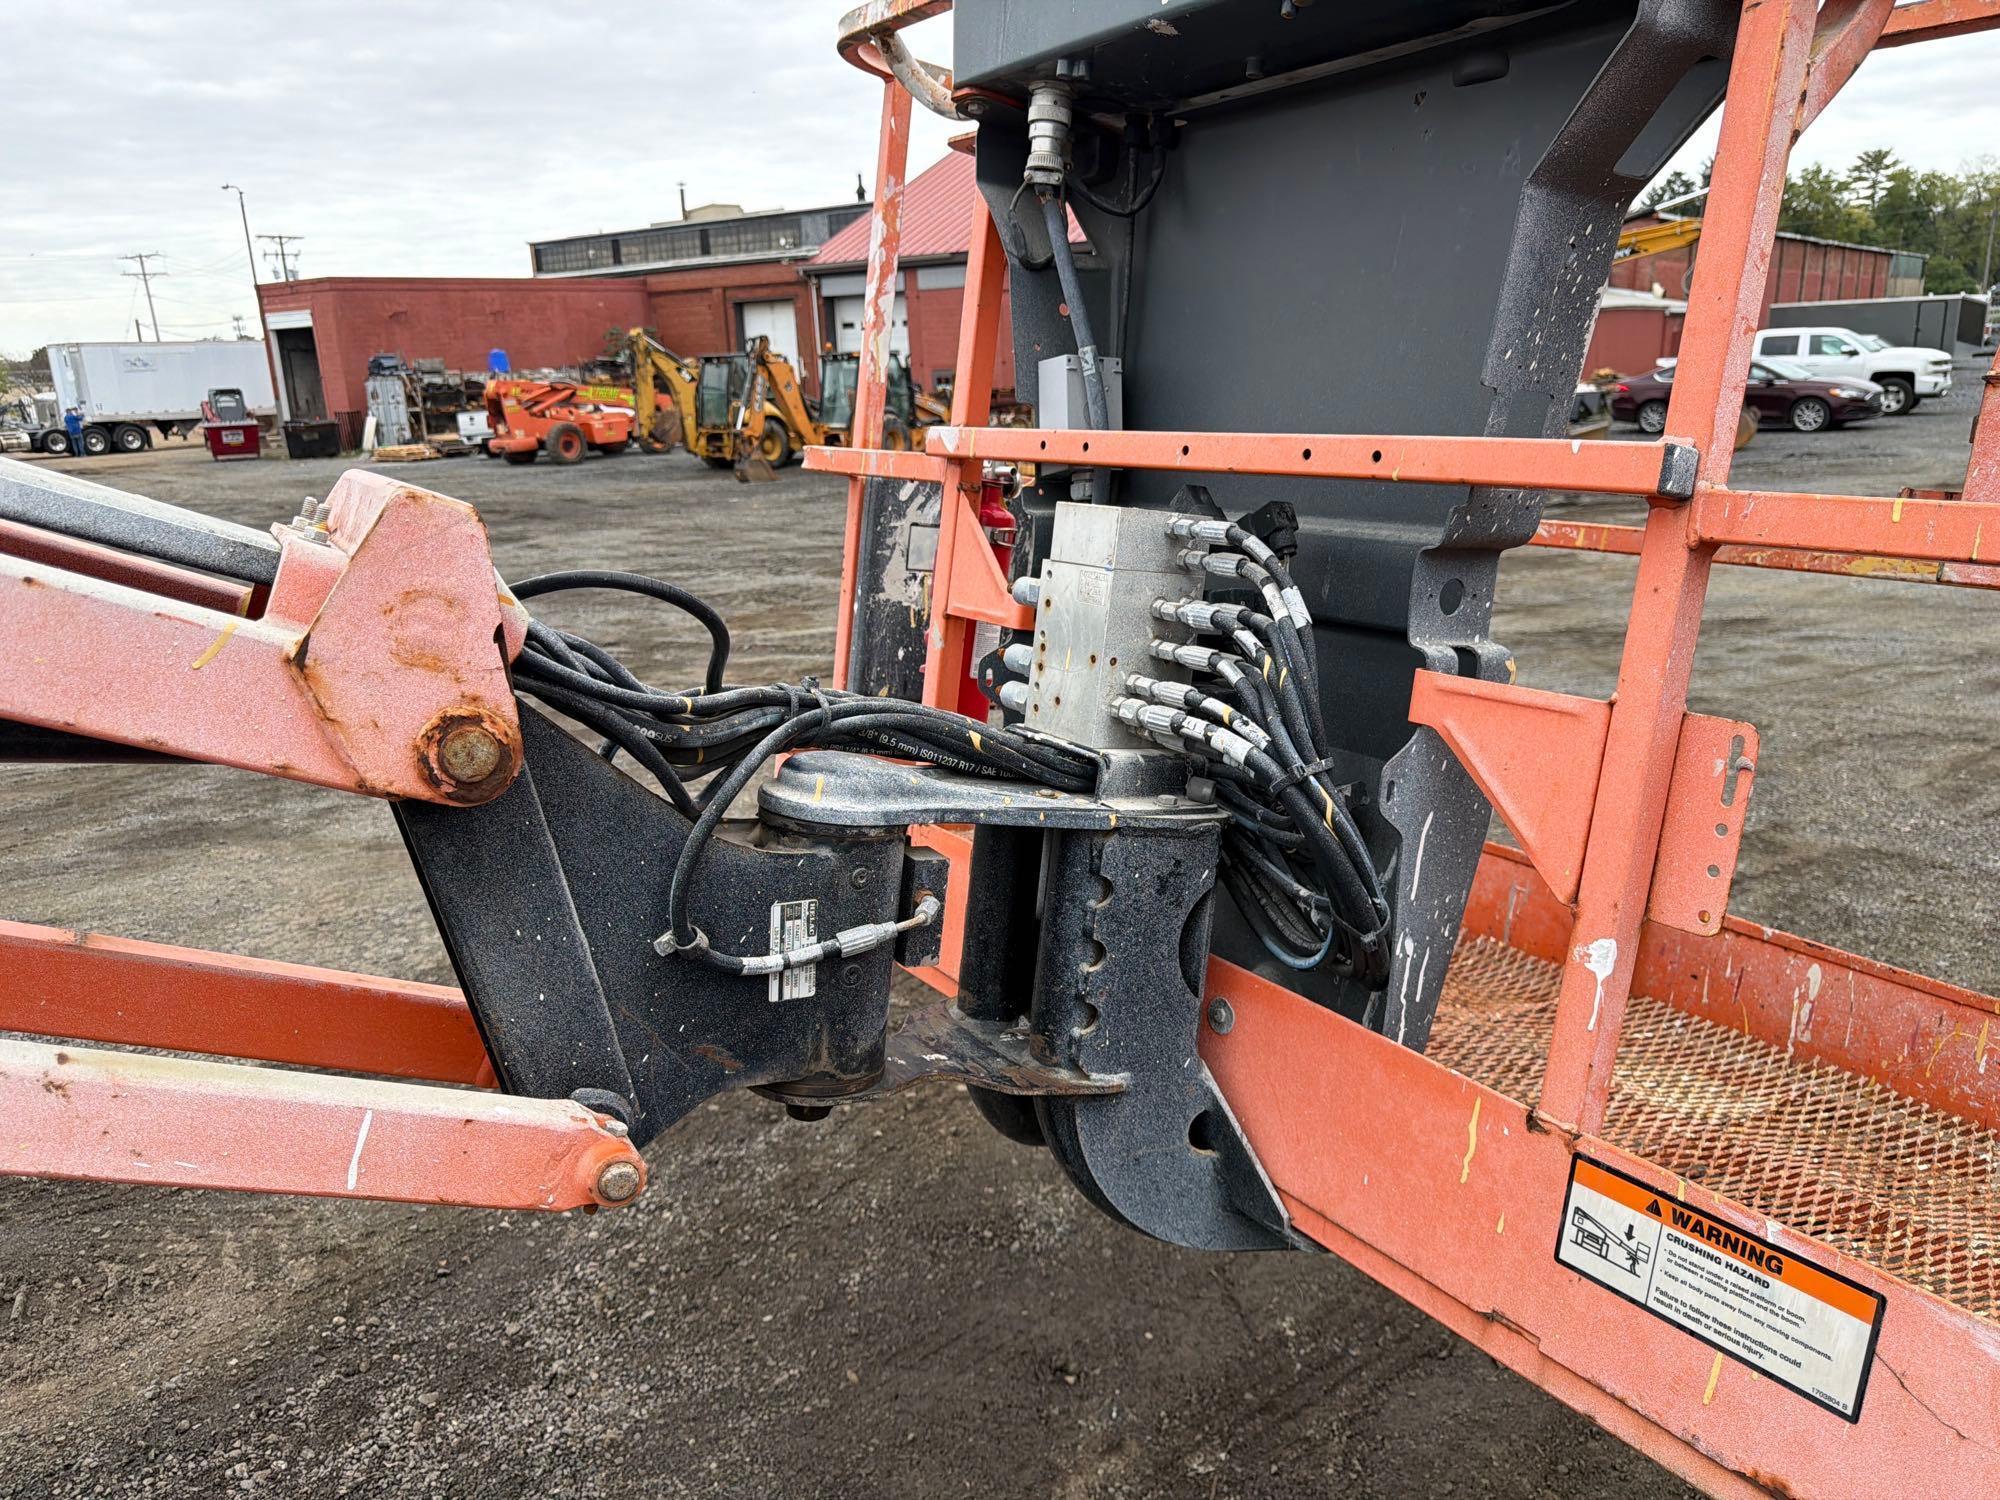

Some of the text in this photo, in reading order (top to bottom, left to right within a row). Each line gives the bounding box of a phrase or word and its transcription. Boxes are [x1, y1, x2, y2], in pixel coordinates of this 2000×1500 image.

[879, 733, 897, 747] (9.5
[897, 741, 919, 755] mm)
[958, 760, 975, 771] R17
[981, 765, 997, 776] SAE
[1666, 1232, 1770, 1289] CRUSHING HAZARD
[1671, 1207, 1784, 1276] WARNING
[1668, 1249, 1676, 1258] Do
[1677, 1254, 1687, 1263] not
[1688, 1259, 1704, 1271] stand
[1706, 1268, 1723, 1281] under
[1730, 1280, 1749, 1294] raised
[1750, 1290, 1776, 1308] platform
[1674, 1260, 1698, 1276] between
[1704, 1275, 1727, 1292] rotating
[1729, 1288, 1754, 1305] platform
[1755, 1301, 1767, 1312] and
[1769, 1308, 1779, 1317] the
[1653, 1295, 1765, 1361] result in death or serious injury.
[1655, 1286, 1801, 1368] Failure to follow these instructions could
[1663, 1270, 1679, 1282] Keep
[1688, 1282, 1703, 1295] body
[1704, 1291, 1719, 1303] parts
[1720, 1300, 1736, 1312] away
[1737, 1308, 1752, 1320] from
[1753, 1317, 1764, 1327] any
[1765, 1322, 1789, 1340] moving
[1790, 1335, 1833, 1362] components.
